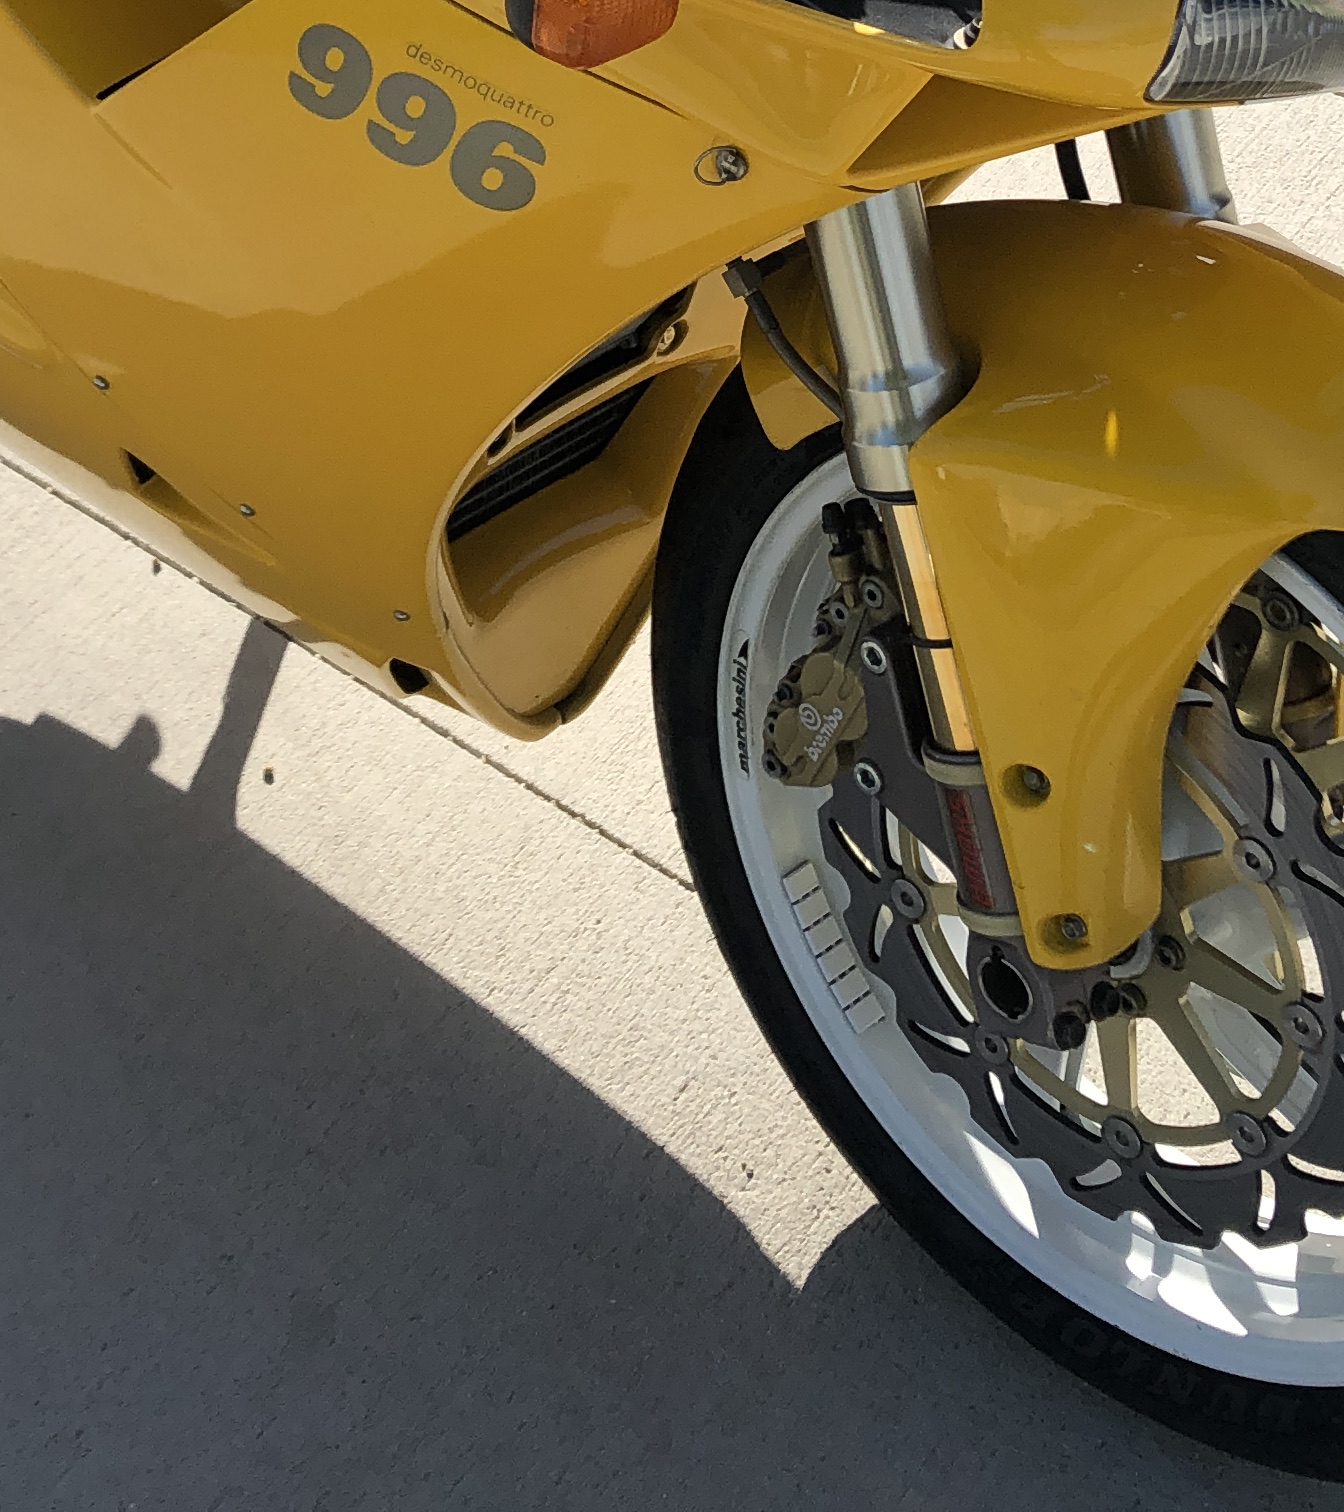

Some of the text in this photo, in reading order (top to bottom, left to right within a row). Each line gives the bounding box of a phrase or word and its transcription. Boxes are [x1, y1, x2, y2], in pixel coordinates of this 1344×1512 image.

[287, 22, 547, 211] 996
[405, 42, 556, 128] desmoquattro
[731, 657, 751, 776] marchesini
[803, 707, 844, 763] brembo
